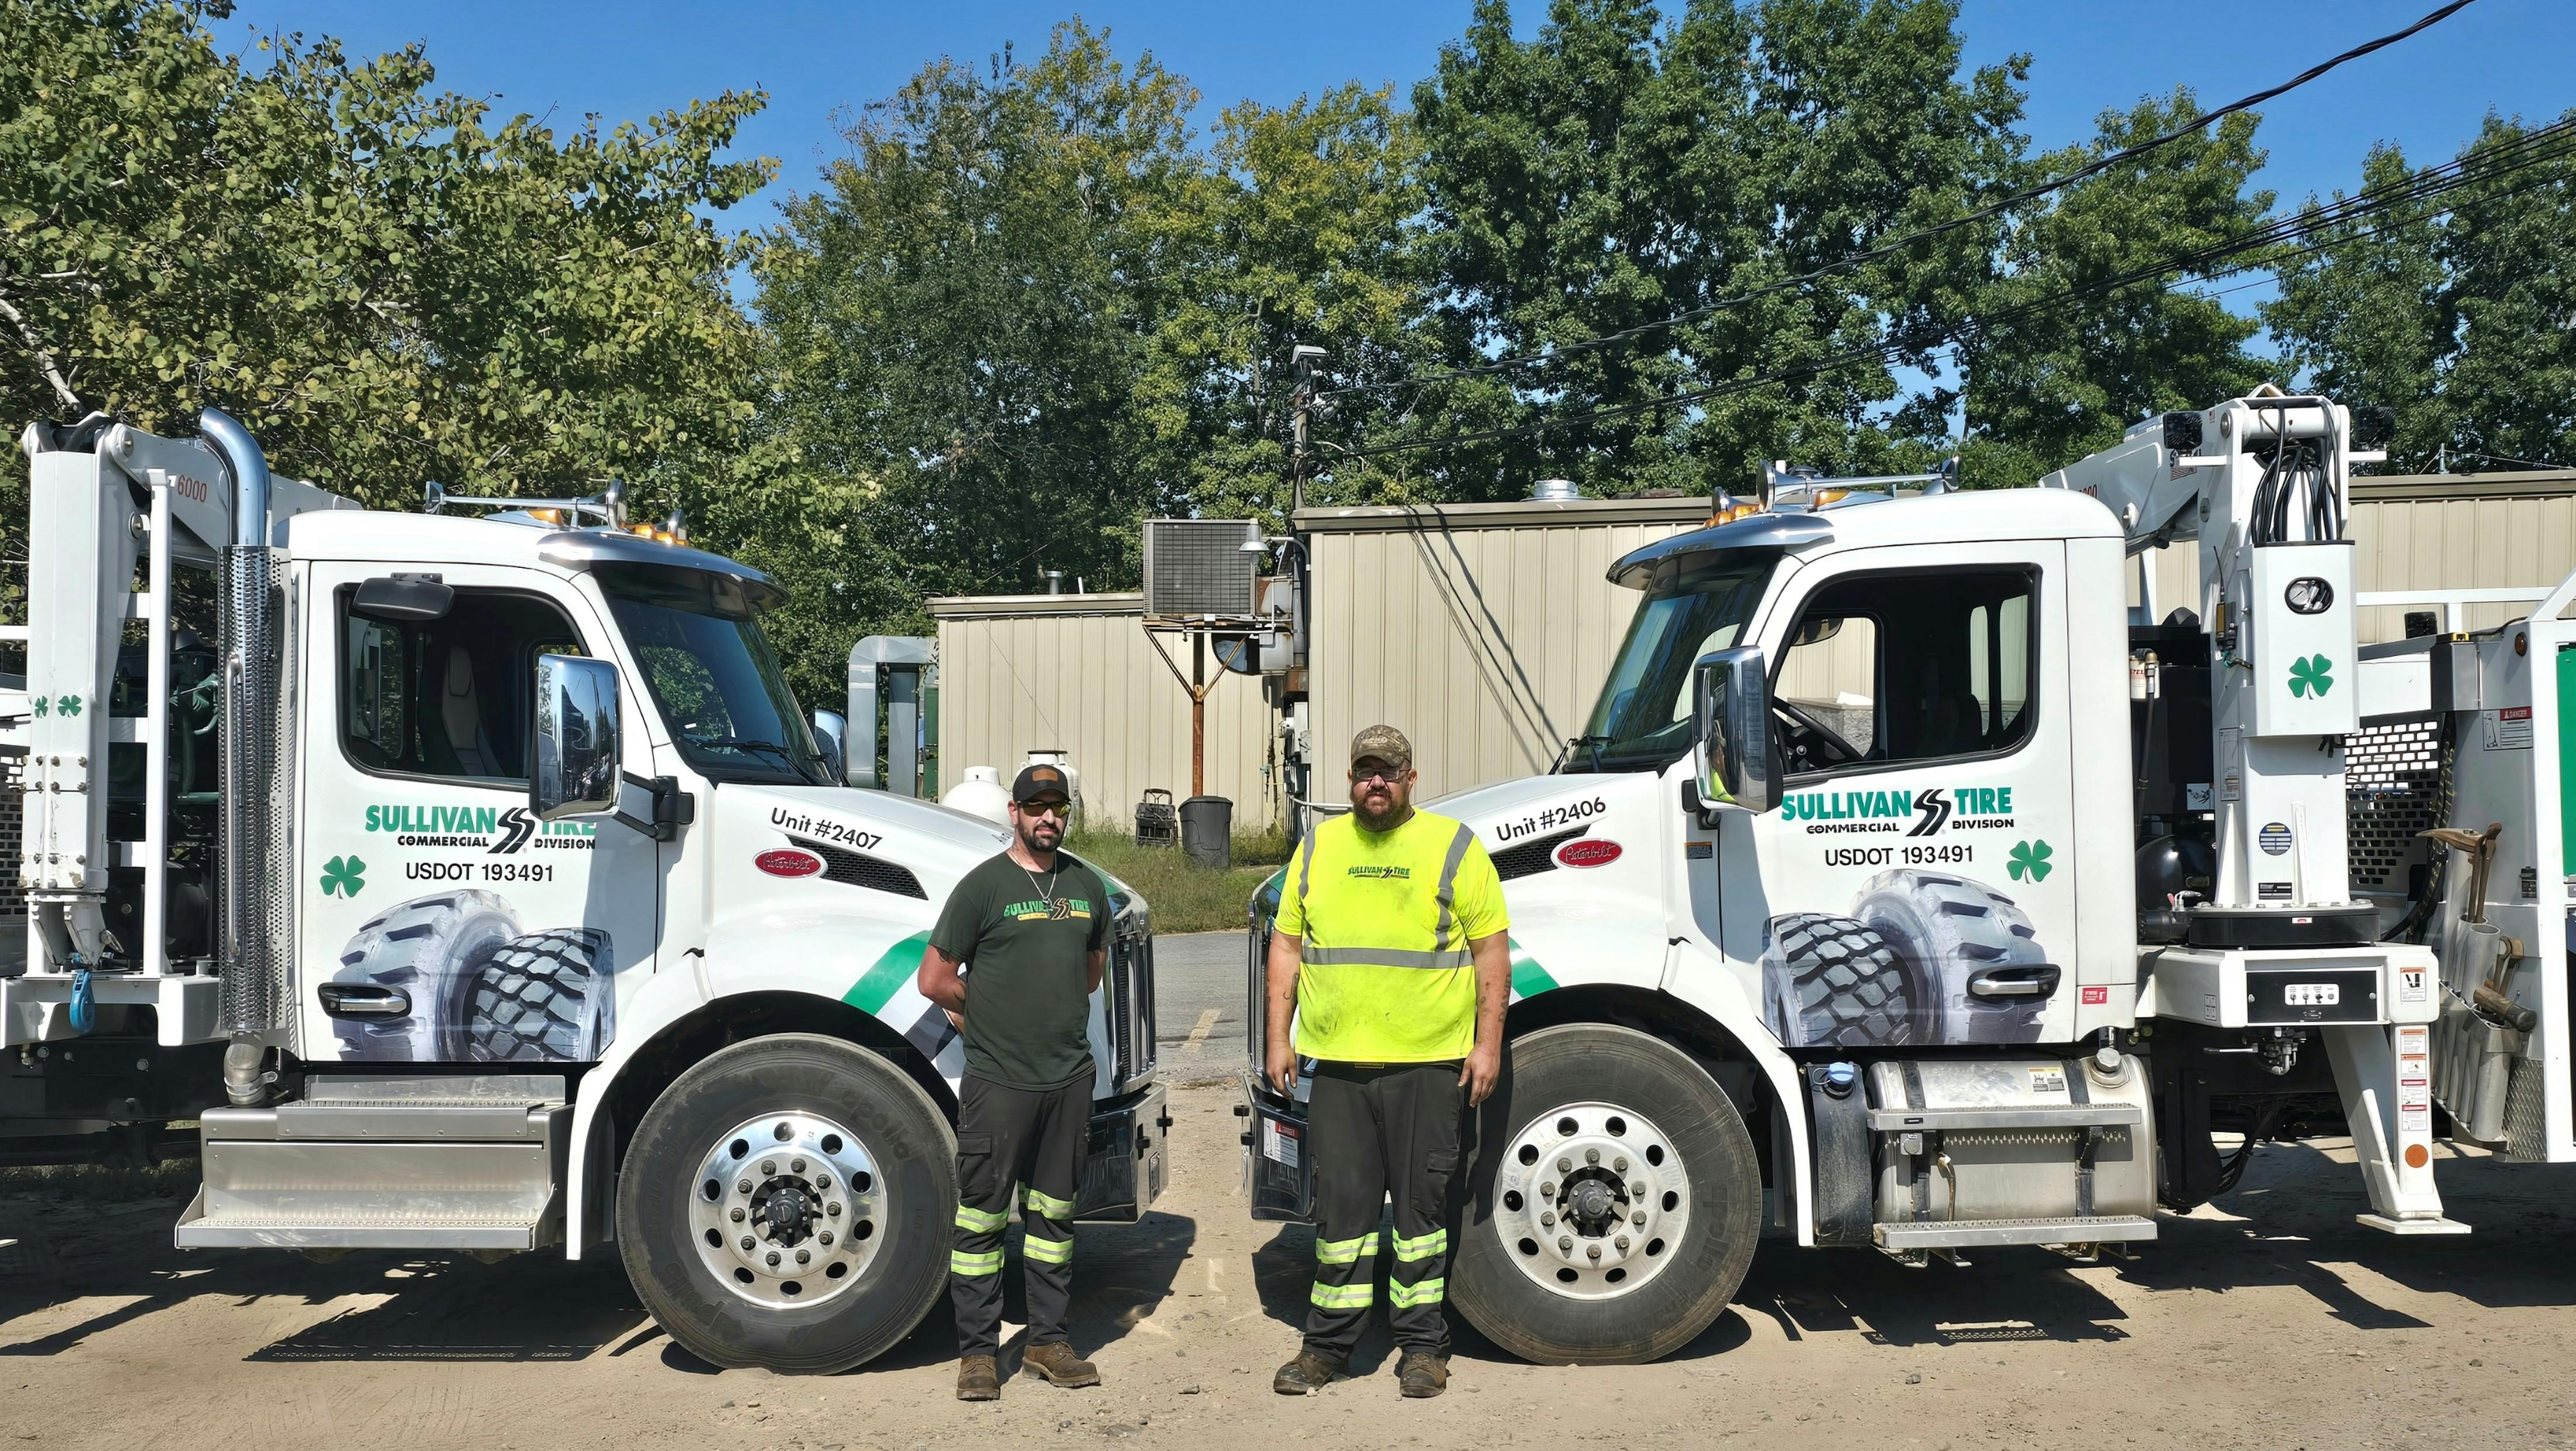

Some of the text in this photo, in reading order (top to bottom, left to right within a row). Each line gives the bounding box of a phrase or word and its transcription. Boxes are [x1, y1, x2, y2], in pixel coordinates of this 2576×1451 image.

[178, 474, 207, 502] 6000
[1781, 787, 2013, 821] SULLIVAN TIRE
[365, 805, 496, 834] SULLIVAN
[771, 807, 883, 850] Unit #2407
[1496, 796, 1606, 841] Unit #2406
[1806, 819, 2014, 834] COMMERCIAL DIVISION
[397, 836, 595, 849] COMMERCIAL DIVISION
[762, 853, 815, 870] Peterbilt
[1565, 844, 1616, 862] Peterbilt
[1825, 845, 1972, 867] USDOT 193491
[406, 862, 553, 882] USDOT 193491
[1348, 866, 1410, 875] SULLIVAN TIRE
[1003, 901, 1047, 917] SULLIVA
[1068, 899, 1090, 912] TIRE
